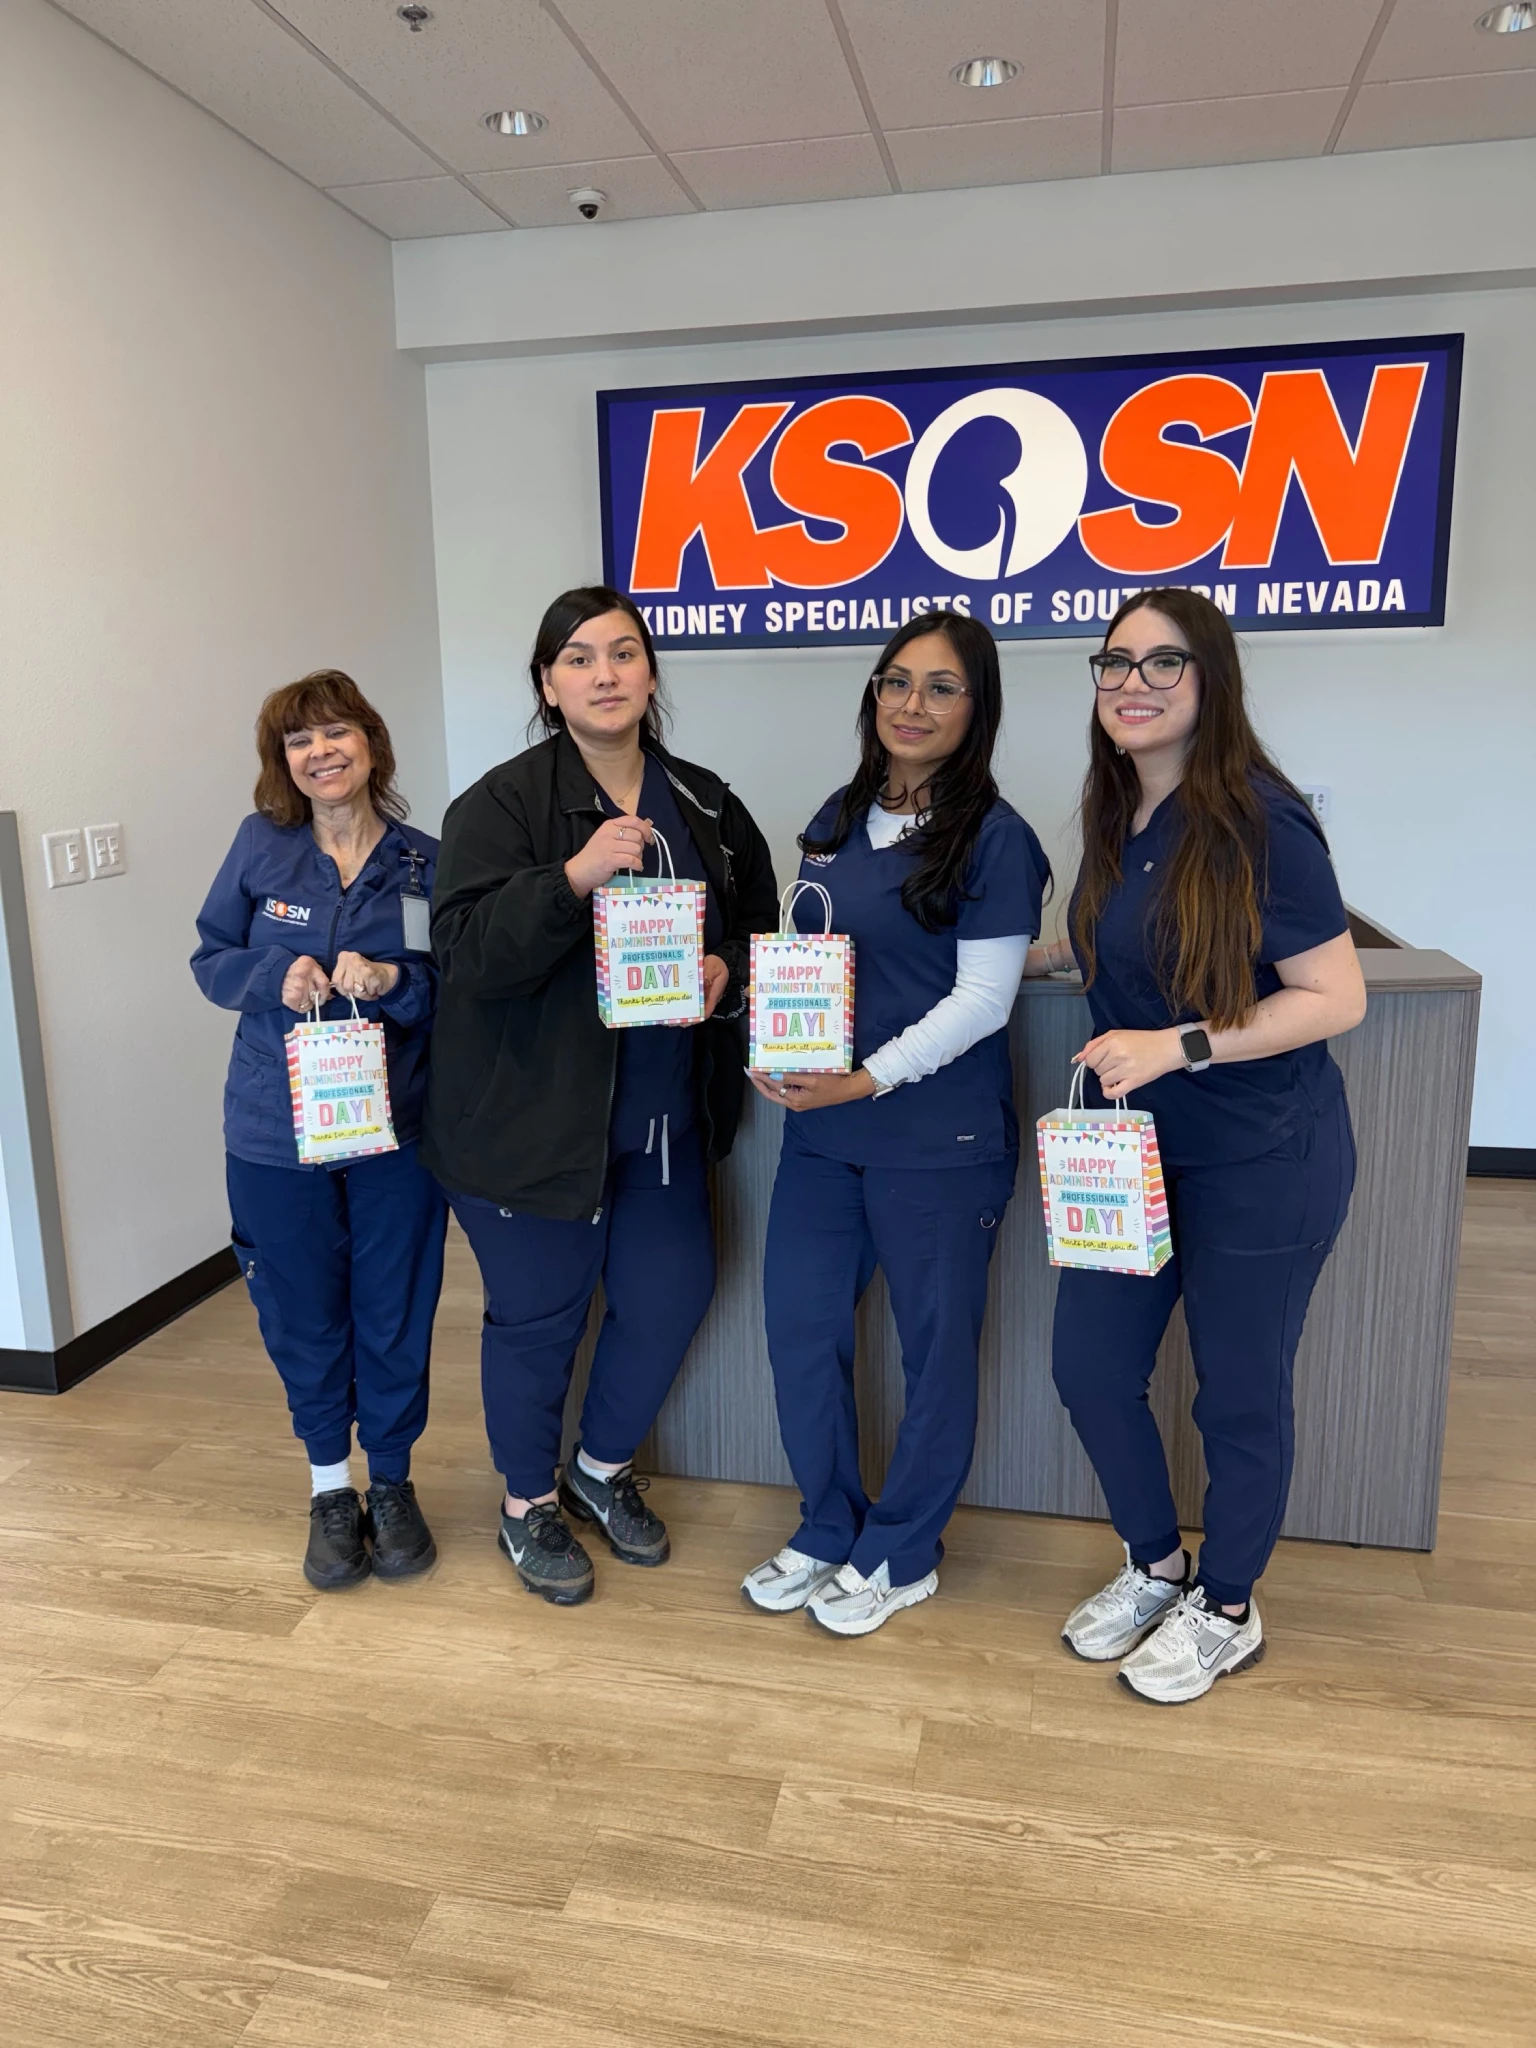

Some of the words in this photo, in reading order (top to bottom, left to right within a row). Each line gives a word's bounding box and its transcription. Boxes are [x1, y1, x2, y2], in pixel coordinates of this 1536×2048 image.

[628, 361, 1430, 594] KSOSN
[636, 603, 747, 636] KIDNEY
[990, 592, 1034, 625] OF
[1257, 579, 1406, 615] NEVADA
[628, 919, 674, 935] HAPPY
[610, 933, 696, 949] ADMINISTRATIVE
[622, 951, 682, 962] PROFESSIONALS
[627, 963, 680, 991] DAY!
[777, 965, 823, 981] HAPPY
[757, 982, 843, 994] ADMINISTRATIVE
[641, 996, 653, 1005] for
[666, 995, 681, 1004] you
[768, 999, 829, 1008] PROFESSIONALS
[772, 1012, 826, 1038] DAY!
[761, 1043, 784, 1051] Thanks
[785, 1043, 799, 1051] for
[811, 1045, 826, 1054] you
[319, 1055, 363, 1072] HAPPY
[304, 1069, 383, 1085] ADMINISTRATIVE
[314, 1086, 373, 1099] PROFESSIONALS
[319, 1098, 372, 1127] DAY!
[1067, 1157, 1117, 1175] HAPPY
[1050, 1174, 1142, 1190] ADMINISTRATIVE
[1061, 1191, 1126, 1204] PROFESSIONALS
[1066, 1206, 1124, 1237] DAY!
[1058, 1237, 1082, 1246] Thanks
[1082, 1240, 1096, 1249] for
[1097, 1241, 1108, 1250] all
[1109, 1244, 1126, 1253] you
